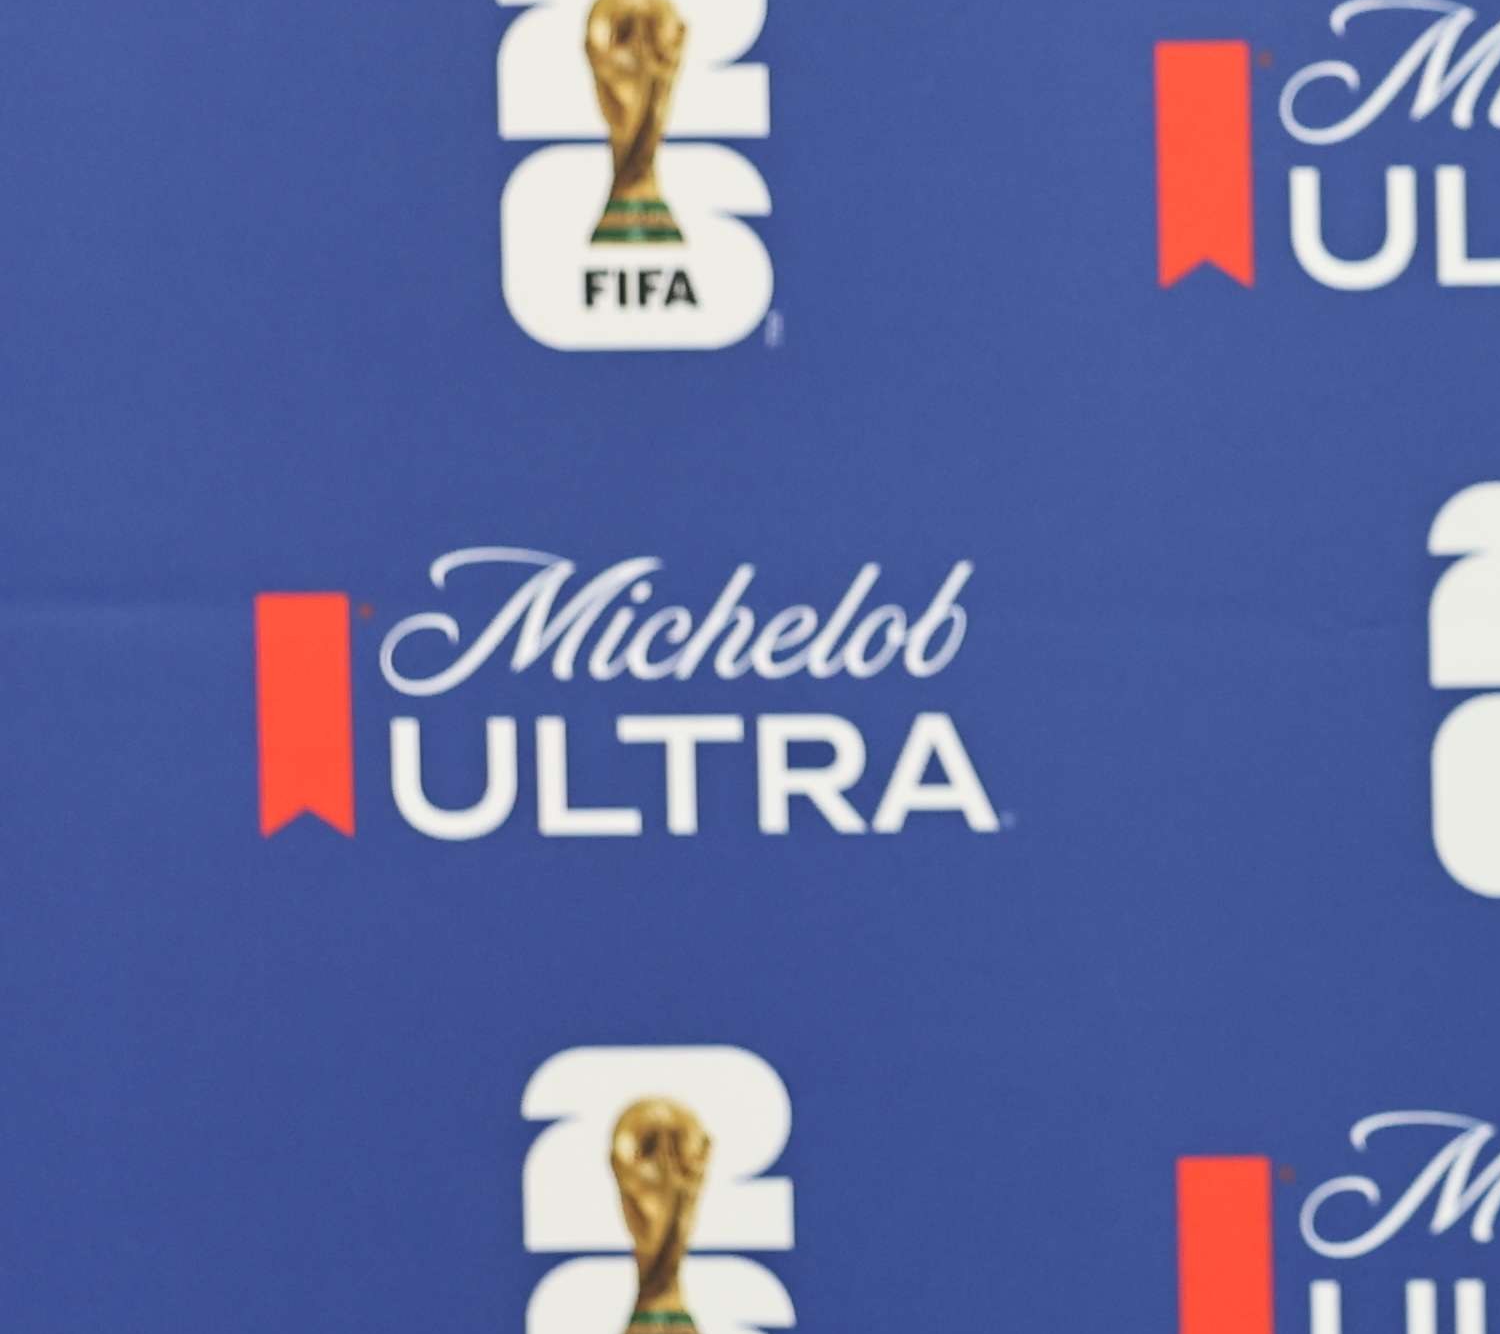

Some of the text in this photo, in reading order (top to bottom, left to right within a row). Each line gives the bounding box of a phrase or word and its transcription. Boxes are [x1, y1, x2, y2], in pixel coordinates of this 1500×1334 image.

[582, 267, 700, 309] FIFA
[378, 545, 975, 698] Michelob
[388, 711, 1001, 842] ULTRA
